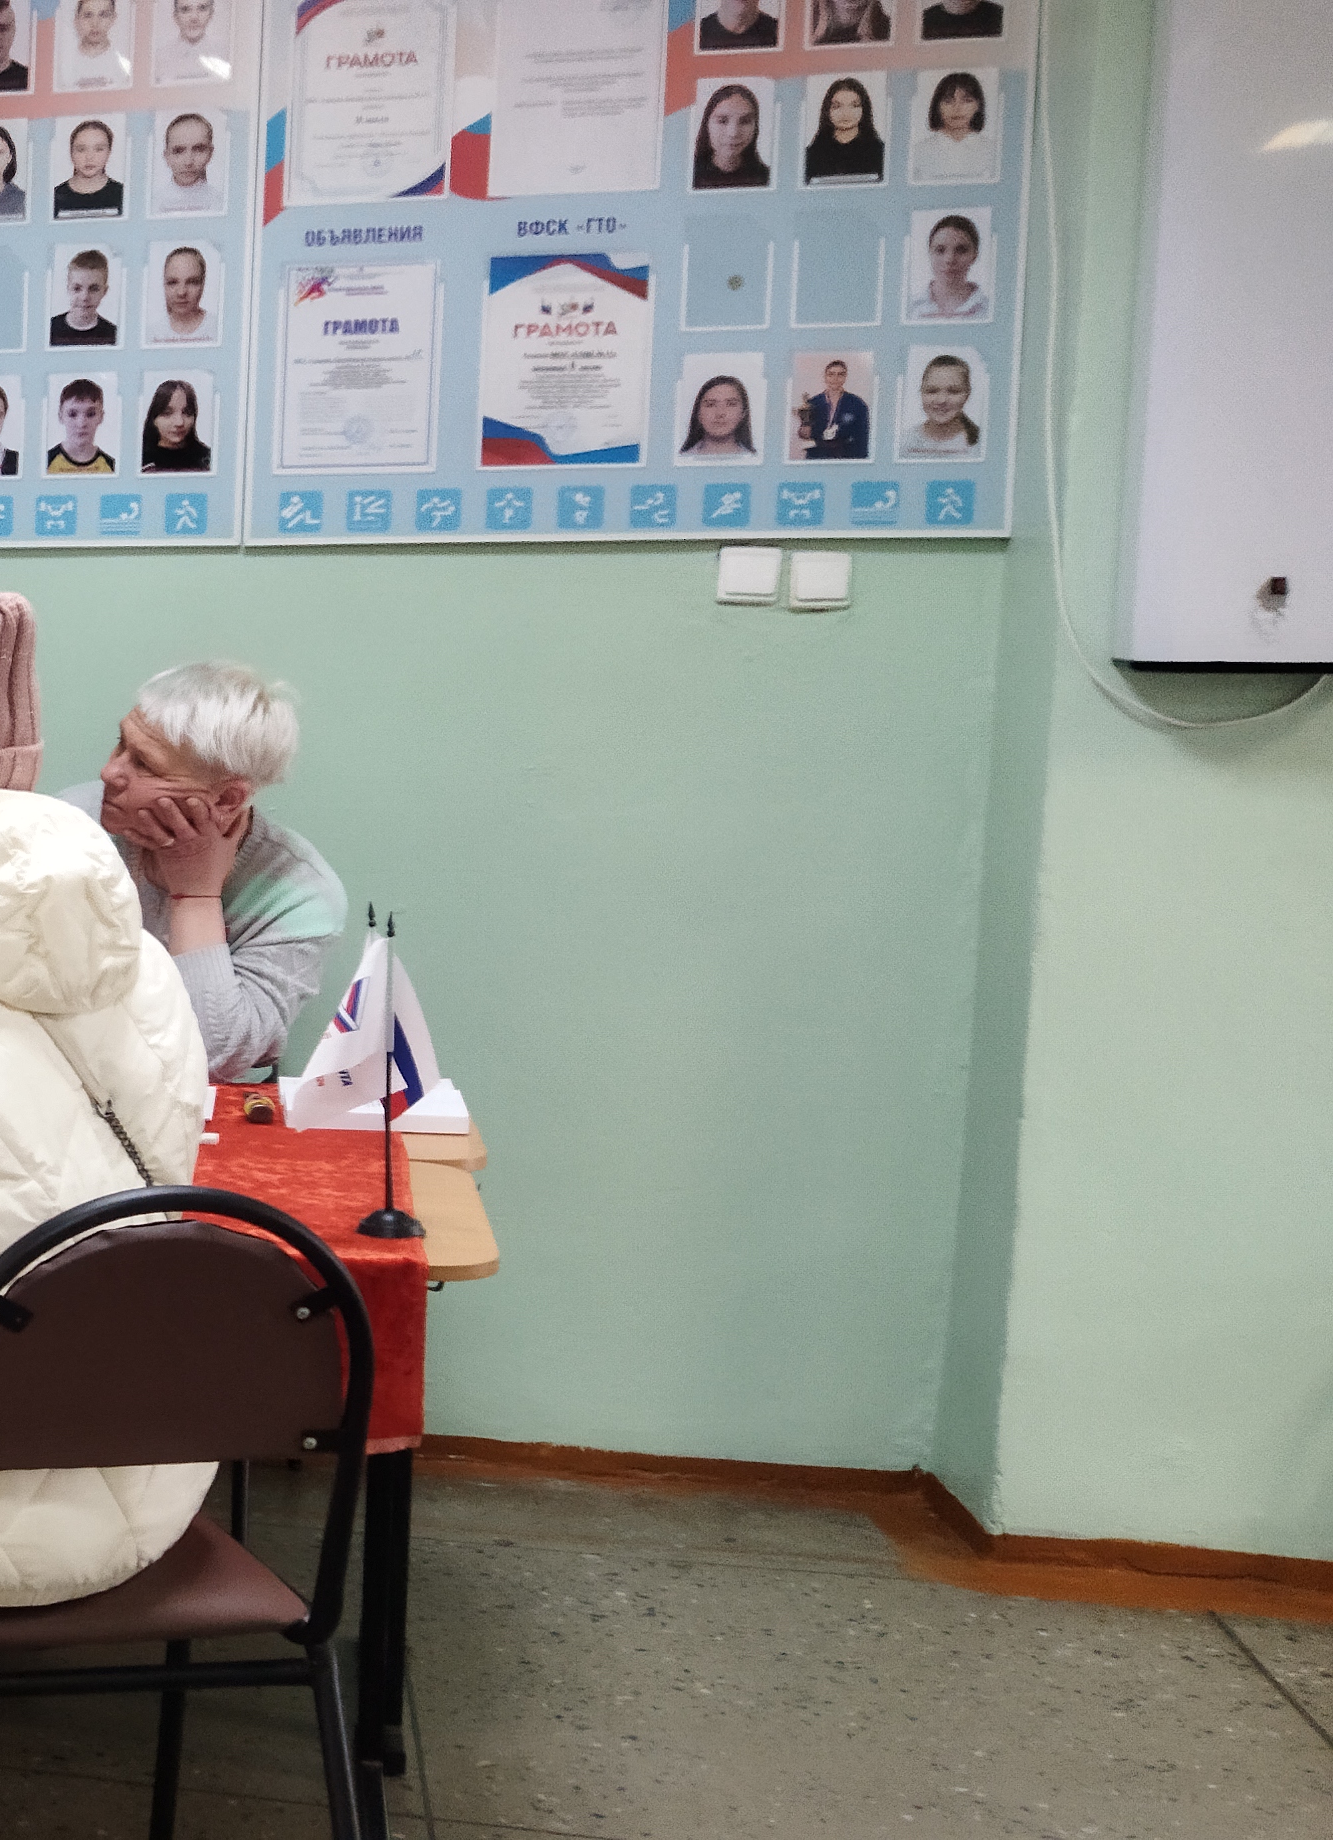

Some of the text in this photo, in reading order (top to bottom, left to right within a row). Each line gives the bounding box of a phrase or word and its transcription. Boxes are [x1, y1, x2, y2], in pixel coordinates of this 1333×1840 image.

[325, 50, 419, 70] ГРАМОТА
[304, 225, 424, 247] ОБЪЯВЛЕНИЯ
[517, 218, 569, 238] ВФСК
[322, 317, 400, 336] ГРАМОТА
[513, 320, 618, 339] ГРАМОТА
